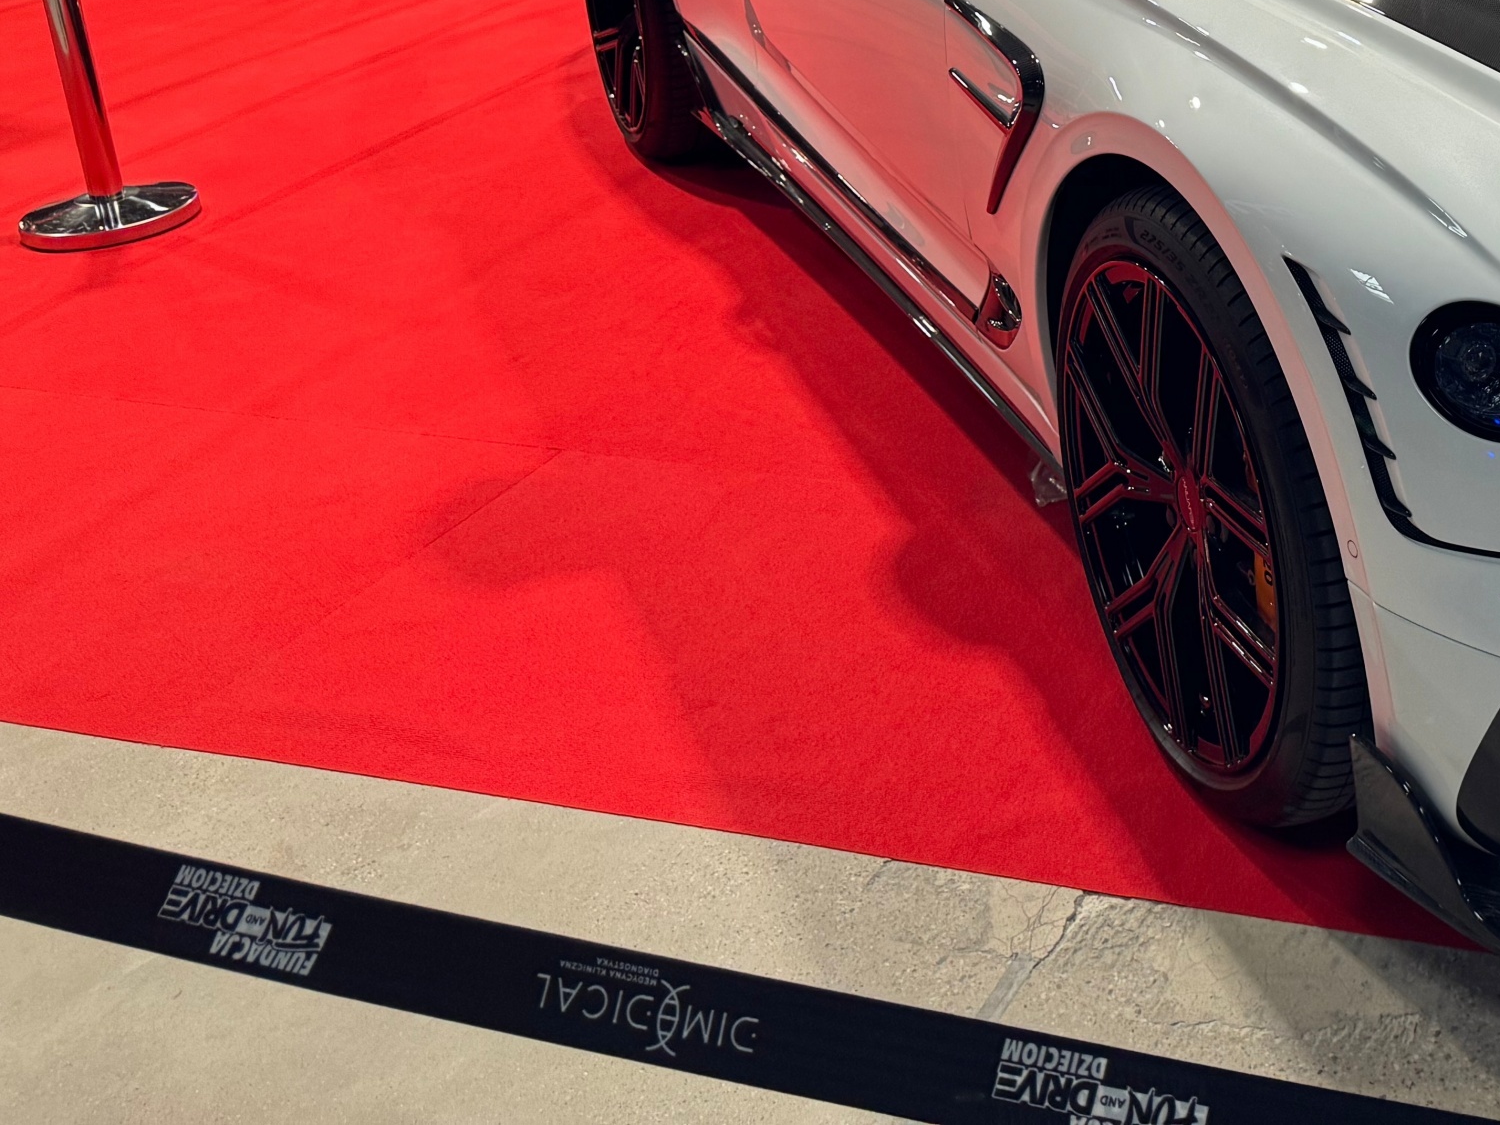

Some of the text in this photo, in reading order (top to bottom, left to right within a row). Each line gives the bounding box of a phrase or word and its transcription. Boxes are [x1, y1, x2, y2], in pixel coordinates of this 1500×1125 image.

[173, 863, 261, 900] DZIECIOM
[158, 885, 251, 934] DRIVE
[245, 914, 268, 928] AND
[209, 930, 319, 977] FUNDACJA
[596, 956, 660, 976] DIAGNOSTYKA
[559, 959, 658, 987] MEDYCYNA KLINICZNA
[1000, 1037, 1108, 1080] DZIECIOM
[991, 1061, 1101, 1117] DRIVE
[1100, 1094, 1127, 1109] AND
